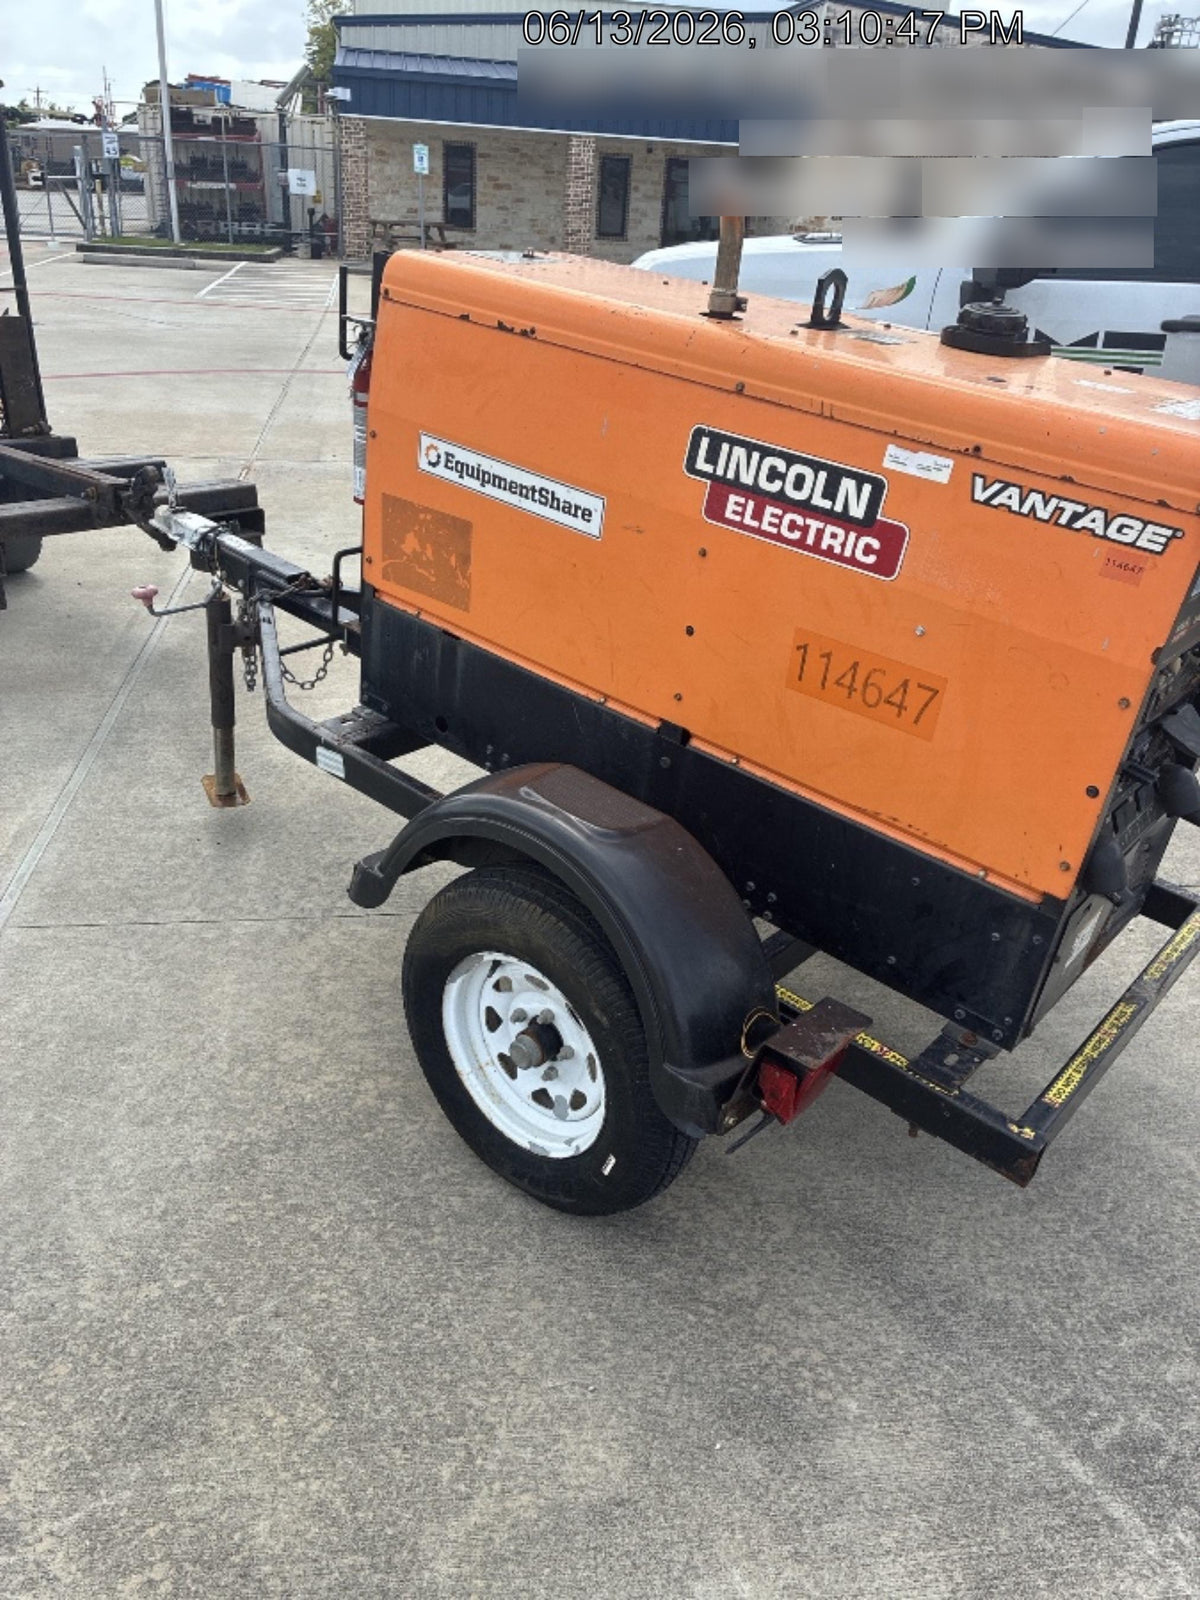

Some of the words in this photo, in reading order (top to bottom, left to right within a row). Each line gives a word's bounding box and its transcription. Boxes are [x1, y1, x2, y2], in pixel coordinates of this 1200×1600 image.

[443, 450, 593, 523] EquipmentShare
[694, 435, 873, 520] LINCOLN
[972, 474, 1174, 553] VANTAGE
[724, 493, 881, 565] ELECTRIC
[796, 643, 940, 726] 114647
